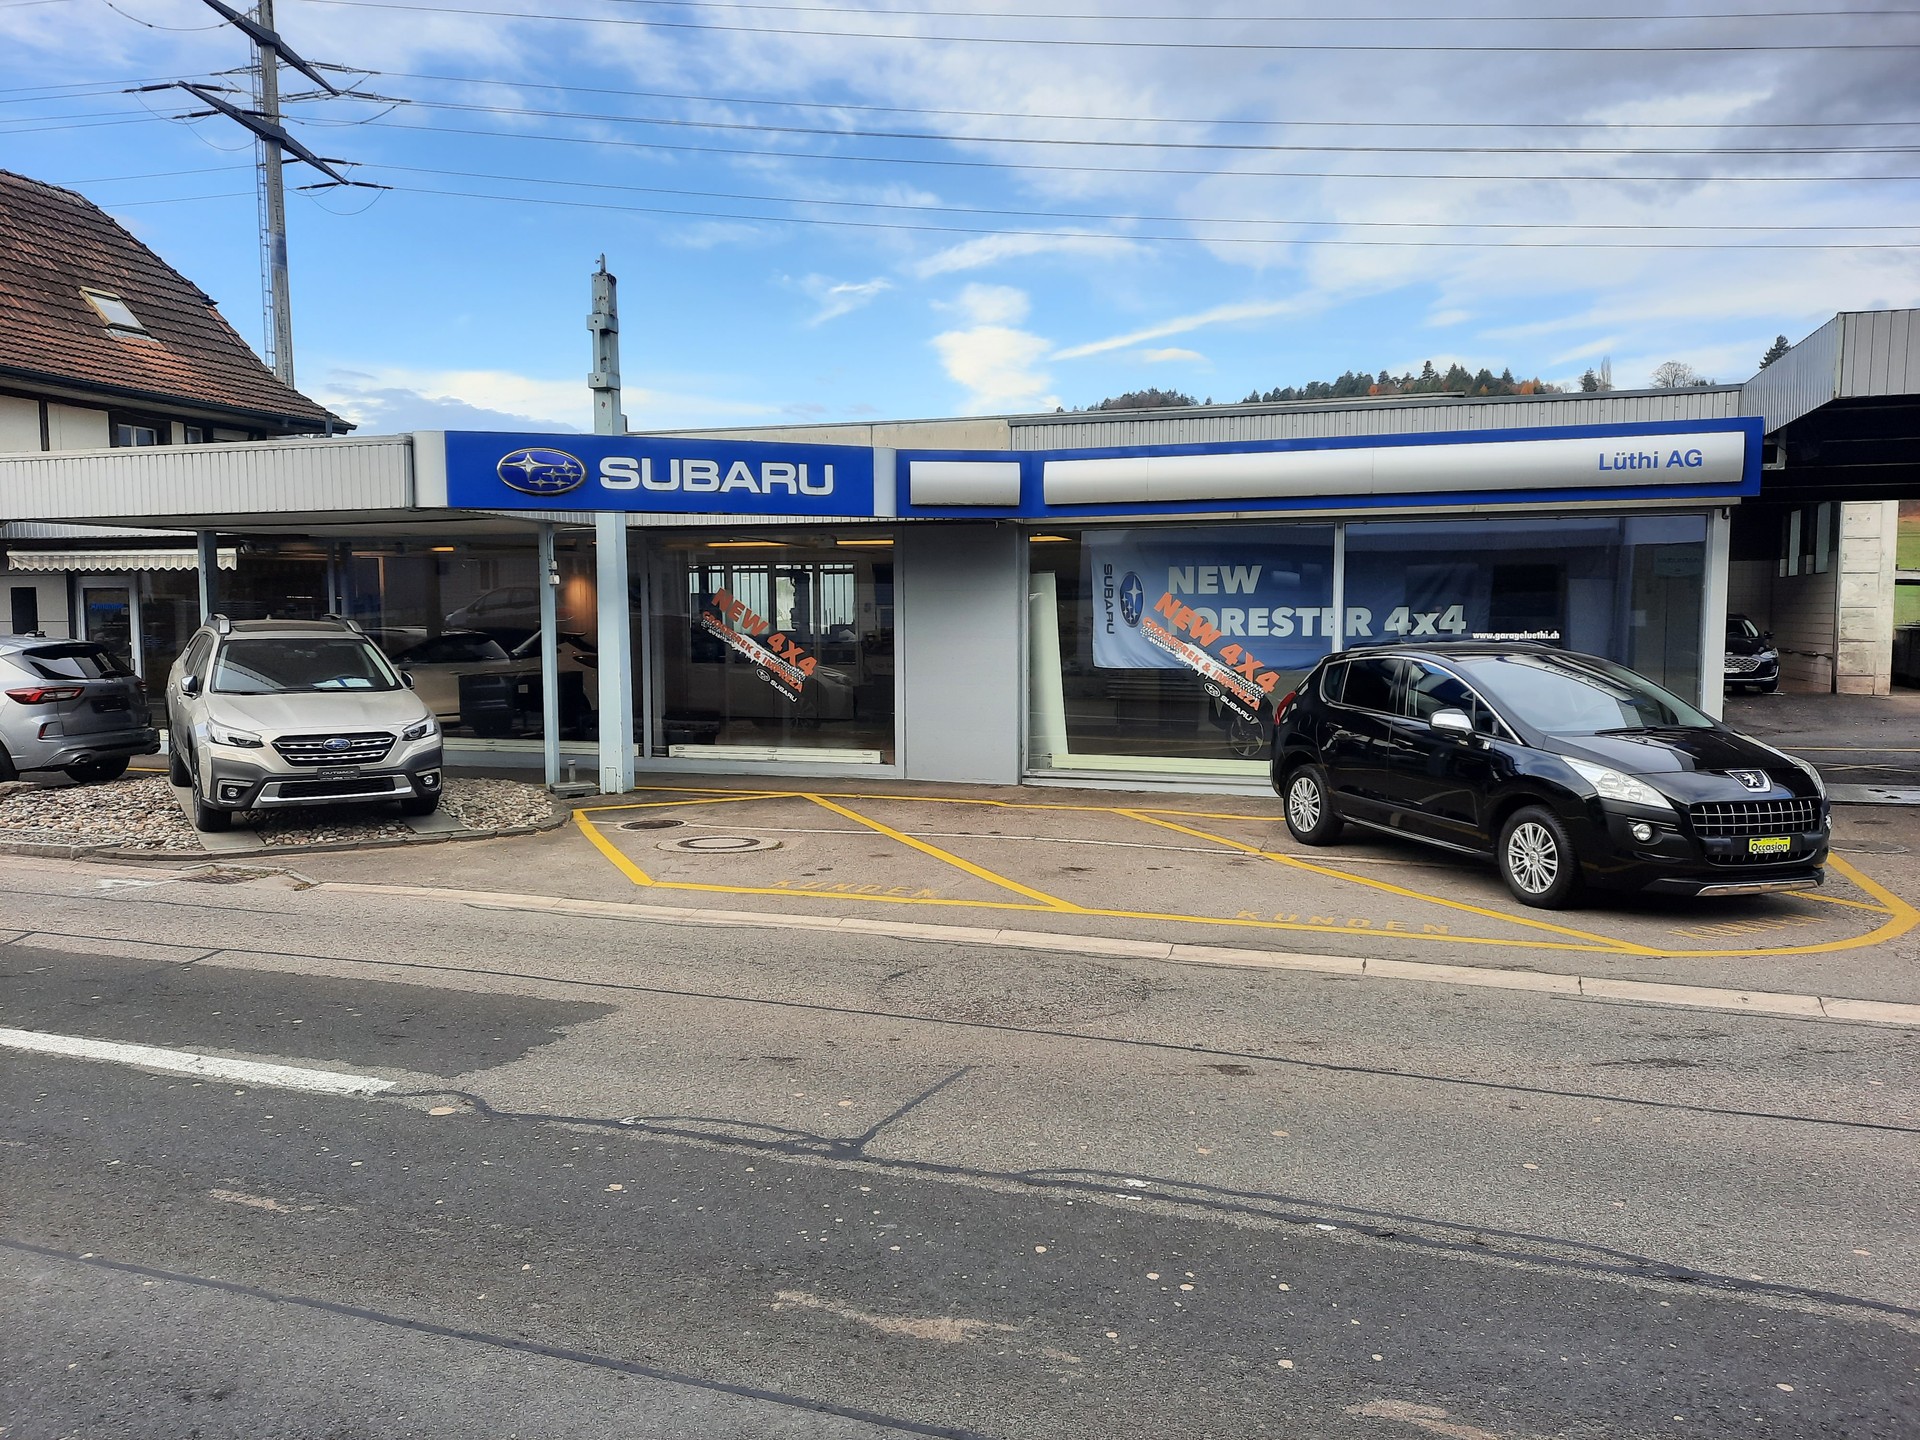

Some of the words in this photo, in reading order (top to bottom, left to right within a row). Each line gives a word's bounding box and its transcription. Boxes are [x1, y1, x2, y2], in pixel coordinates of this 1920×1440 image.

[1599, 451, 1659, 471] Lüthi
[1666, 448, 1704, 468] AG
[599, 456, 835, 496] SUBARU
[1168, 565, 1262, 595] NEW
[1103, 563, 1116, 635] SUBARU
[711, 587, 769, 637] NEW
[766, 632, 818, 677] 4X4
[1384, 605, 1467, 636] 4x4
[1472, 630, 1560, 641] www.garageluethi.ch
[1153, 591, 1223, 648] NEW
[1219, 643, 1280, 693] 4X4
[753, 650, 762, 660] &
[762, 656, 804, 693] IMPREZA
[769, 679, 798, 703] SUBARU
[1201, 662, 1212, 673] &
[1211, 669, 1261, 712] IMPREZA
[1219, 695, 1253, 722] SUBARU
[1751, 843, 1788, 852] Occasion
[769, 879, 942, 899] KUNDEN
[1235, 909, 1451, 935] KUNDEN
